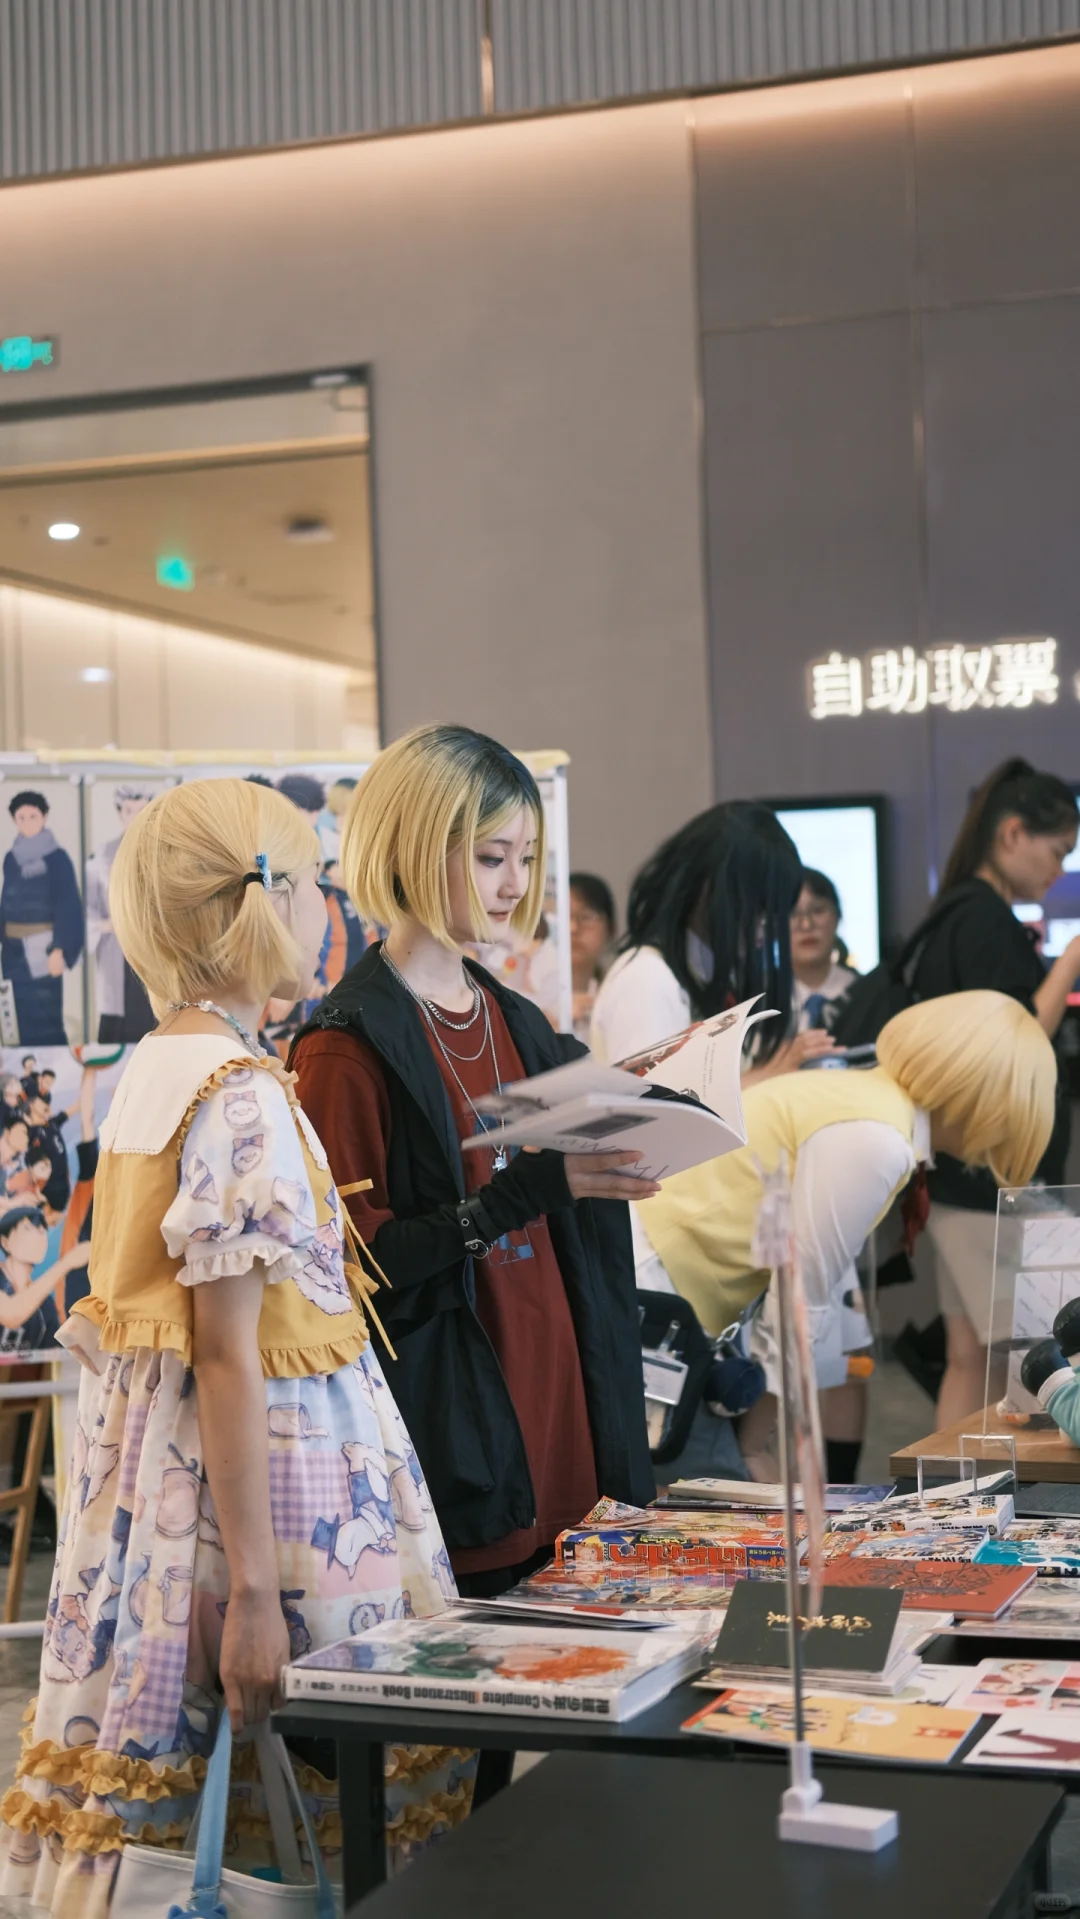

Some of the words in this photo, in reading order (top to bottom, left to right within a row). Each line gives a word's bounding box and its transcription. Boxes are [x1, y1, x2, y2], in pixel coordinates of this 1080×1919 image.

[810, 638, 1060, 720] 自助取票
[382, 1685, 411, 1699] Book
